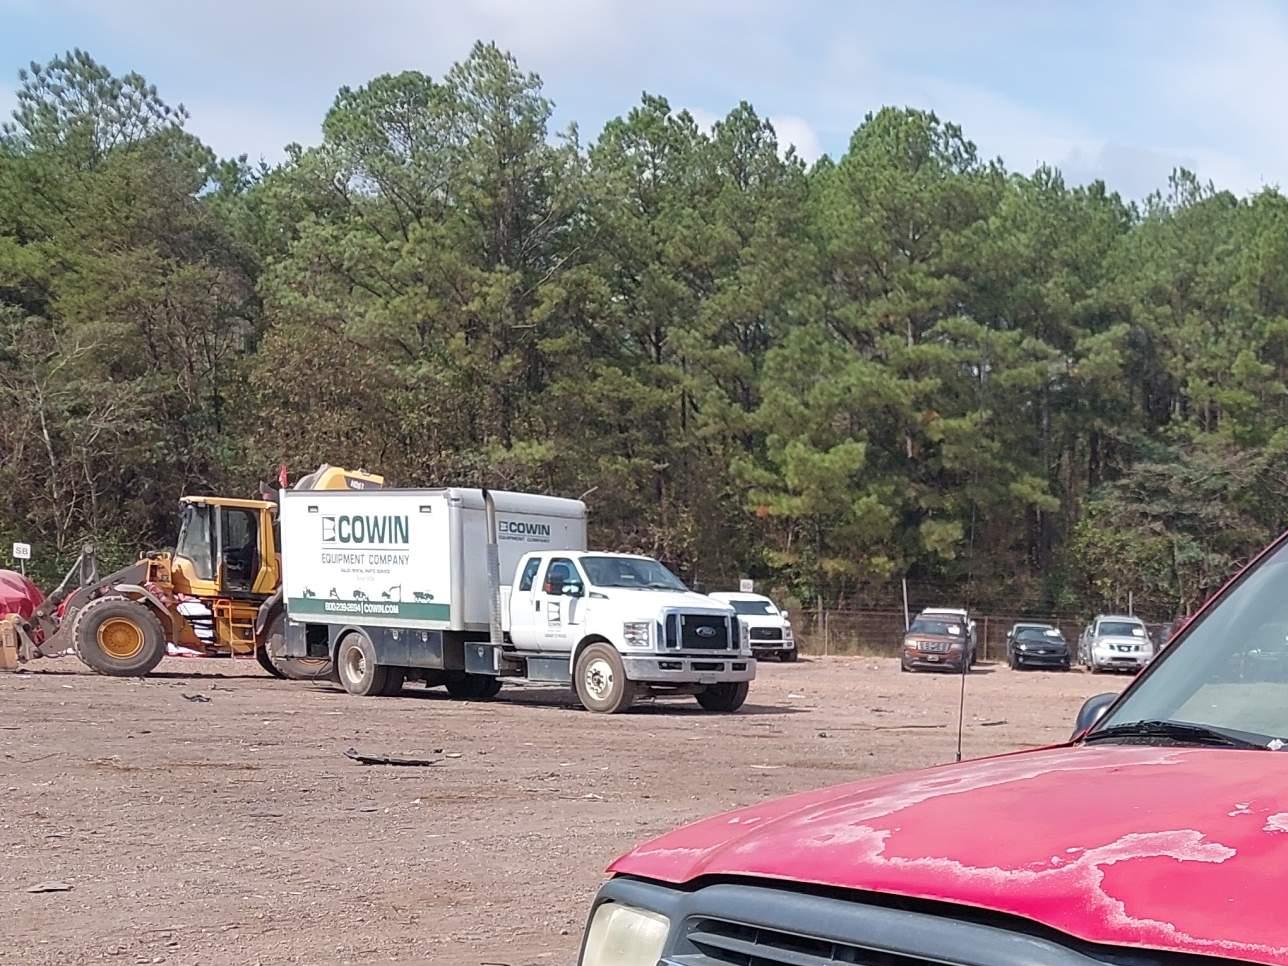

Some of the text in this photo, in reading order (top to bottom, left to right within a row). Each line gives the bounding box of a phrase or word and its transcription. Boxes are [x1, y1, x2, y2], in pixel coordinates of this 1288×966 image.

[338, 514, 409, 544] COWIN
[509, 521, 550, 535] COWIN
[321, 552, 410, 566] EQUIPMENT COMPANY
